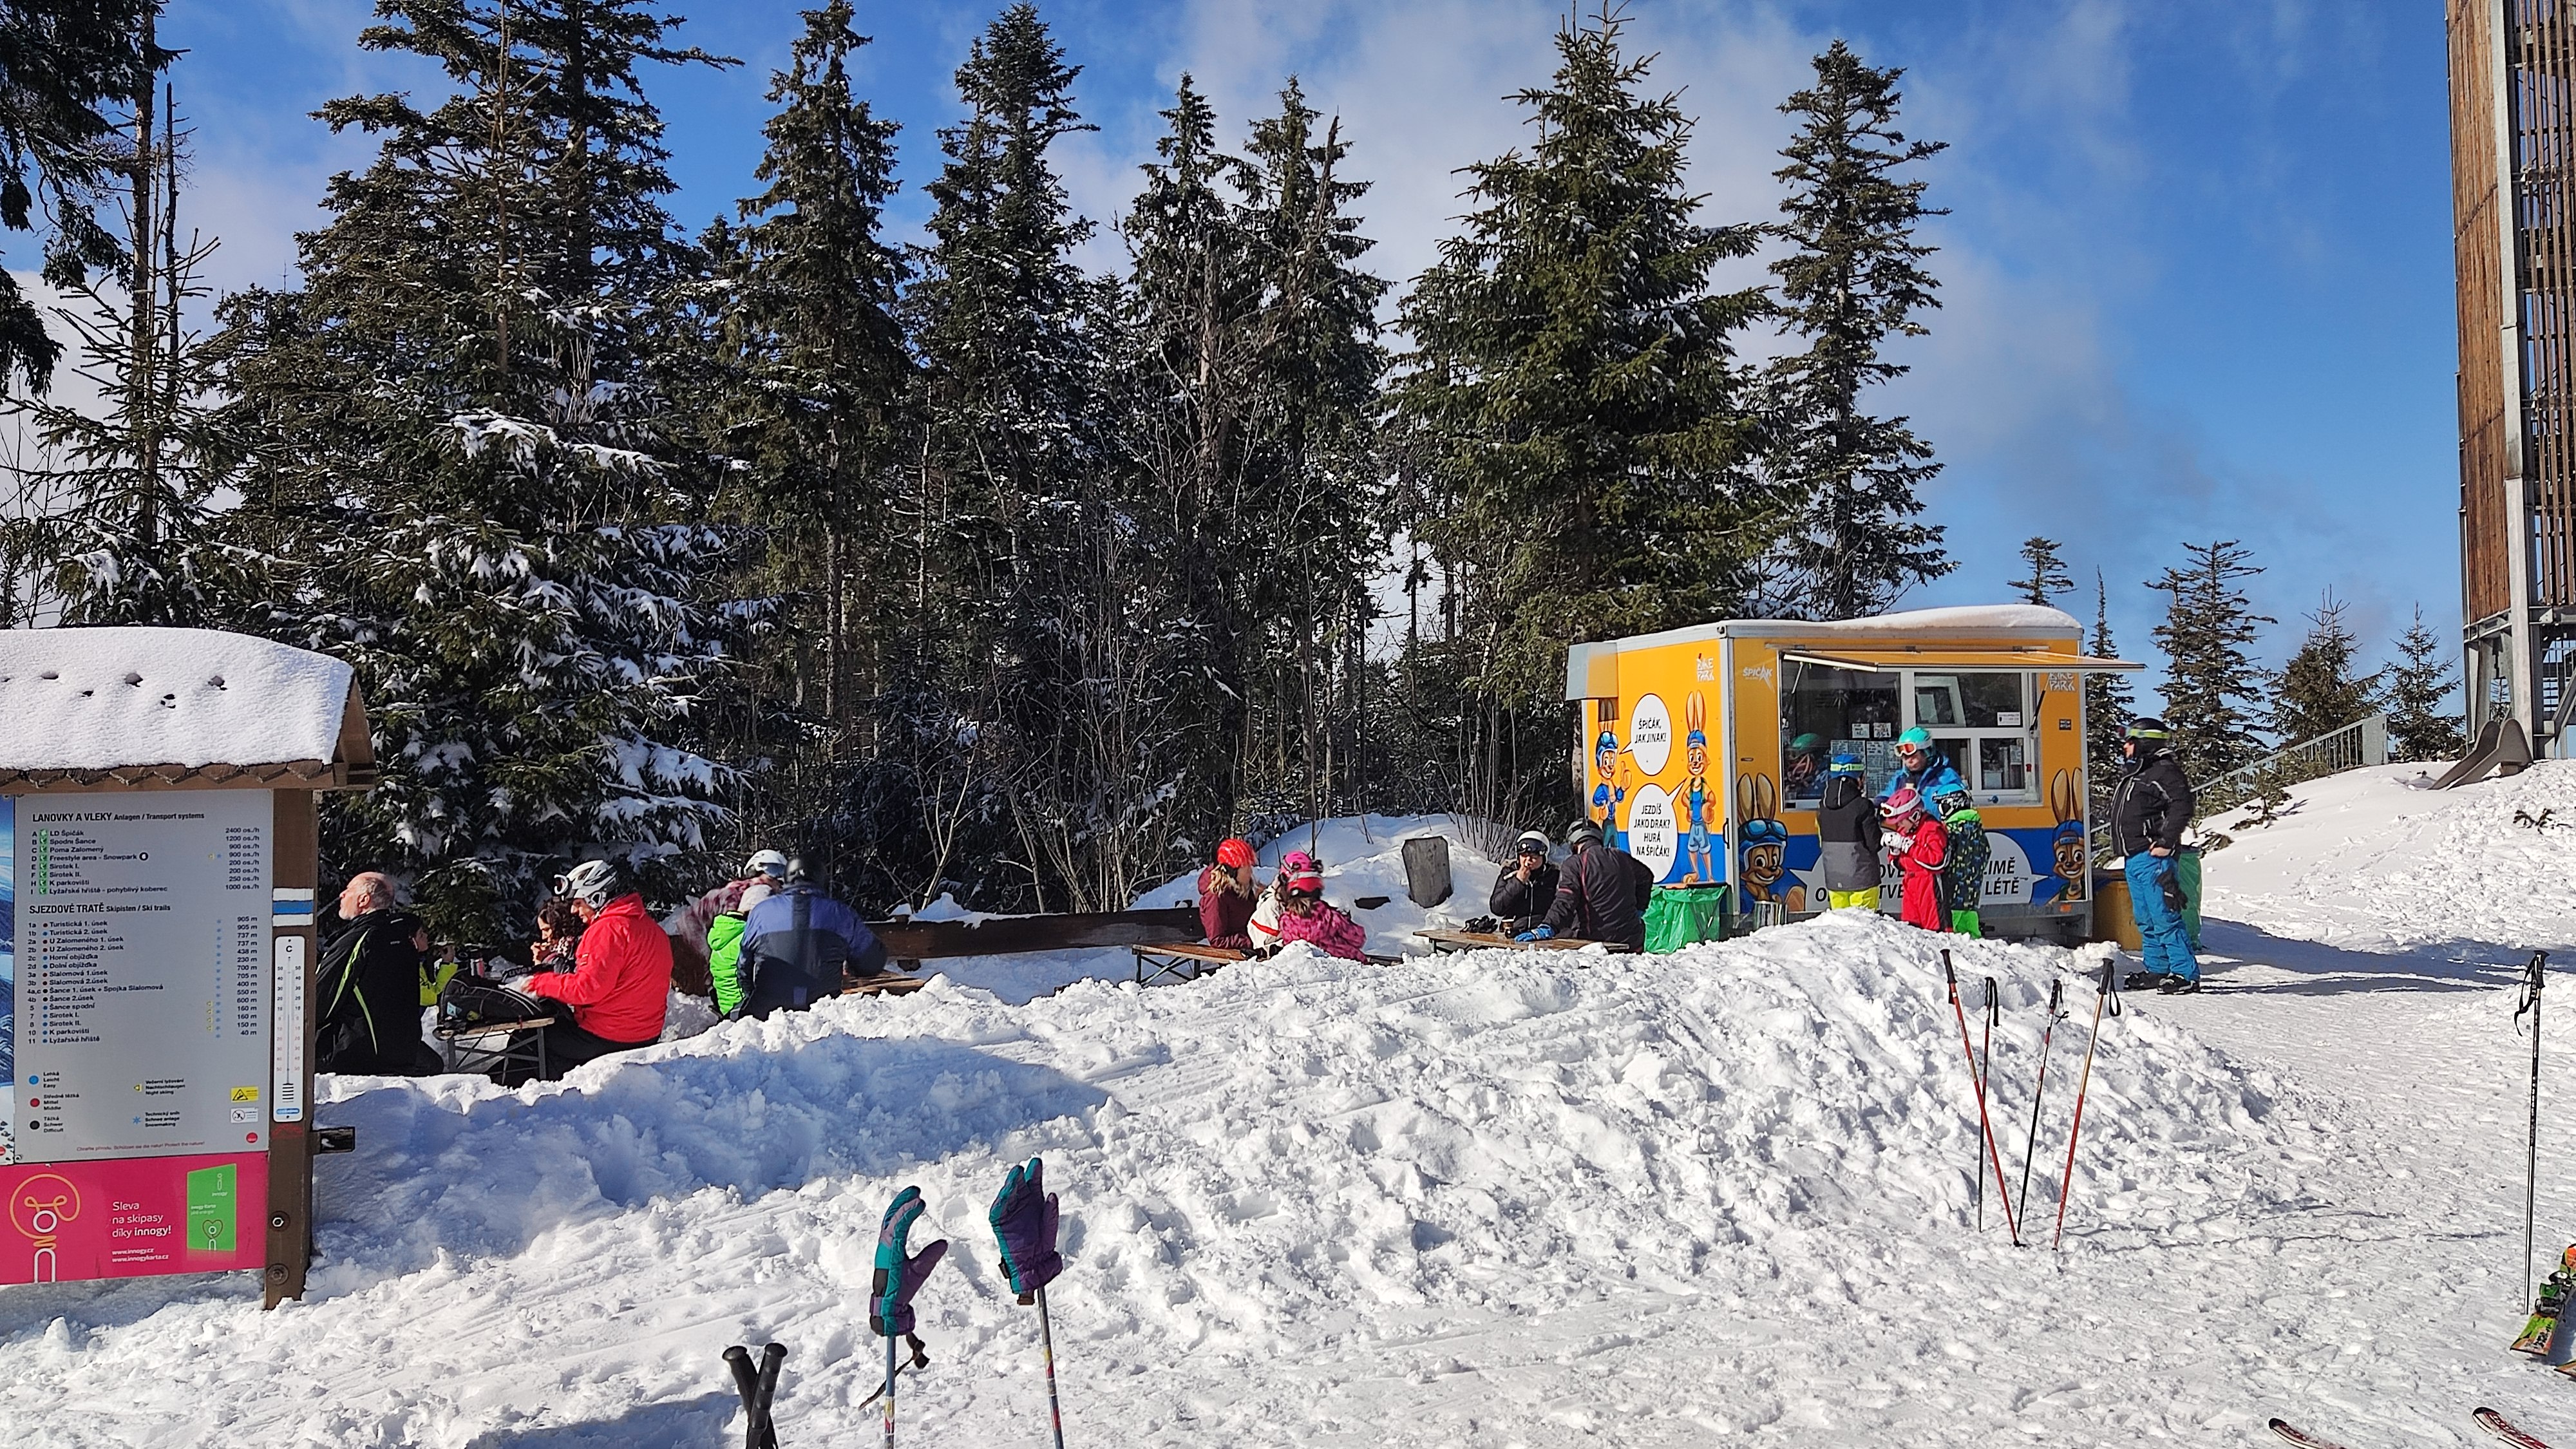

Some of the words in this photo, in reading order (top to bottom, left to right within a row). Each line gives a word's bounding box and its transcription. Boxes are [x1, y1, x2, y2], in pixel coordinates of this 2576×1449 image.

[2049, 680, 2075, 691] PARK
[1638, 717, 1662, 730] ŠPIČÁK,
[1634, 734, 1646, 744] JAK
[1647, 732, 1667, 743] JINAK!
[1641, 803, 1662, 815] JEZDÍŠ
[33, 813, 73, 822] LANOVKY
[84, 812, 112, 820] VLEKY
[1634, 819, 1650, 828] JAKO
[1650, 819, 1671, 829] DRAK?
[1643, 831, 1661, 842] HURÁ
[1636, 846, 1645, 856] NA
[1646, 844, 1670, 857] ŠPIČÁK!
[1984, 857, 2016, 875] IMĚ
[1985, 876, 2020, 895] LÉTĚ
[30, 903, 75, 914] SJEZDOVÉ
[76, 902, 104, 913] TRATĚ
[113, 1202, 139, 1211] Sleva
[128, 1214, 163, 1224] skipasy
[113, 1228, 132, 1238] díky
[135, 1226, 171, 1236] innogy!
[112, 1247, 155, 1256] www.innogy.cz
[112, 1254, 169, 1263] www.innogykarta.cz
